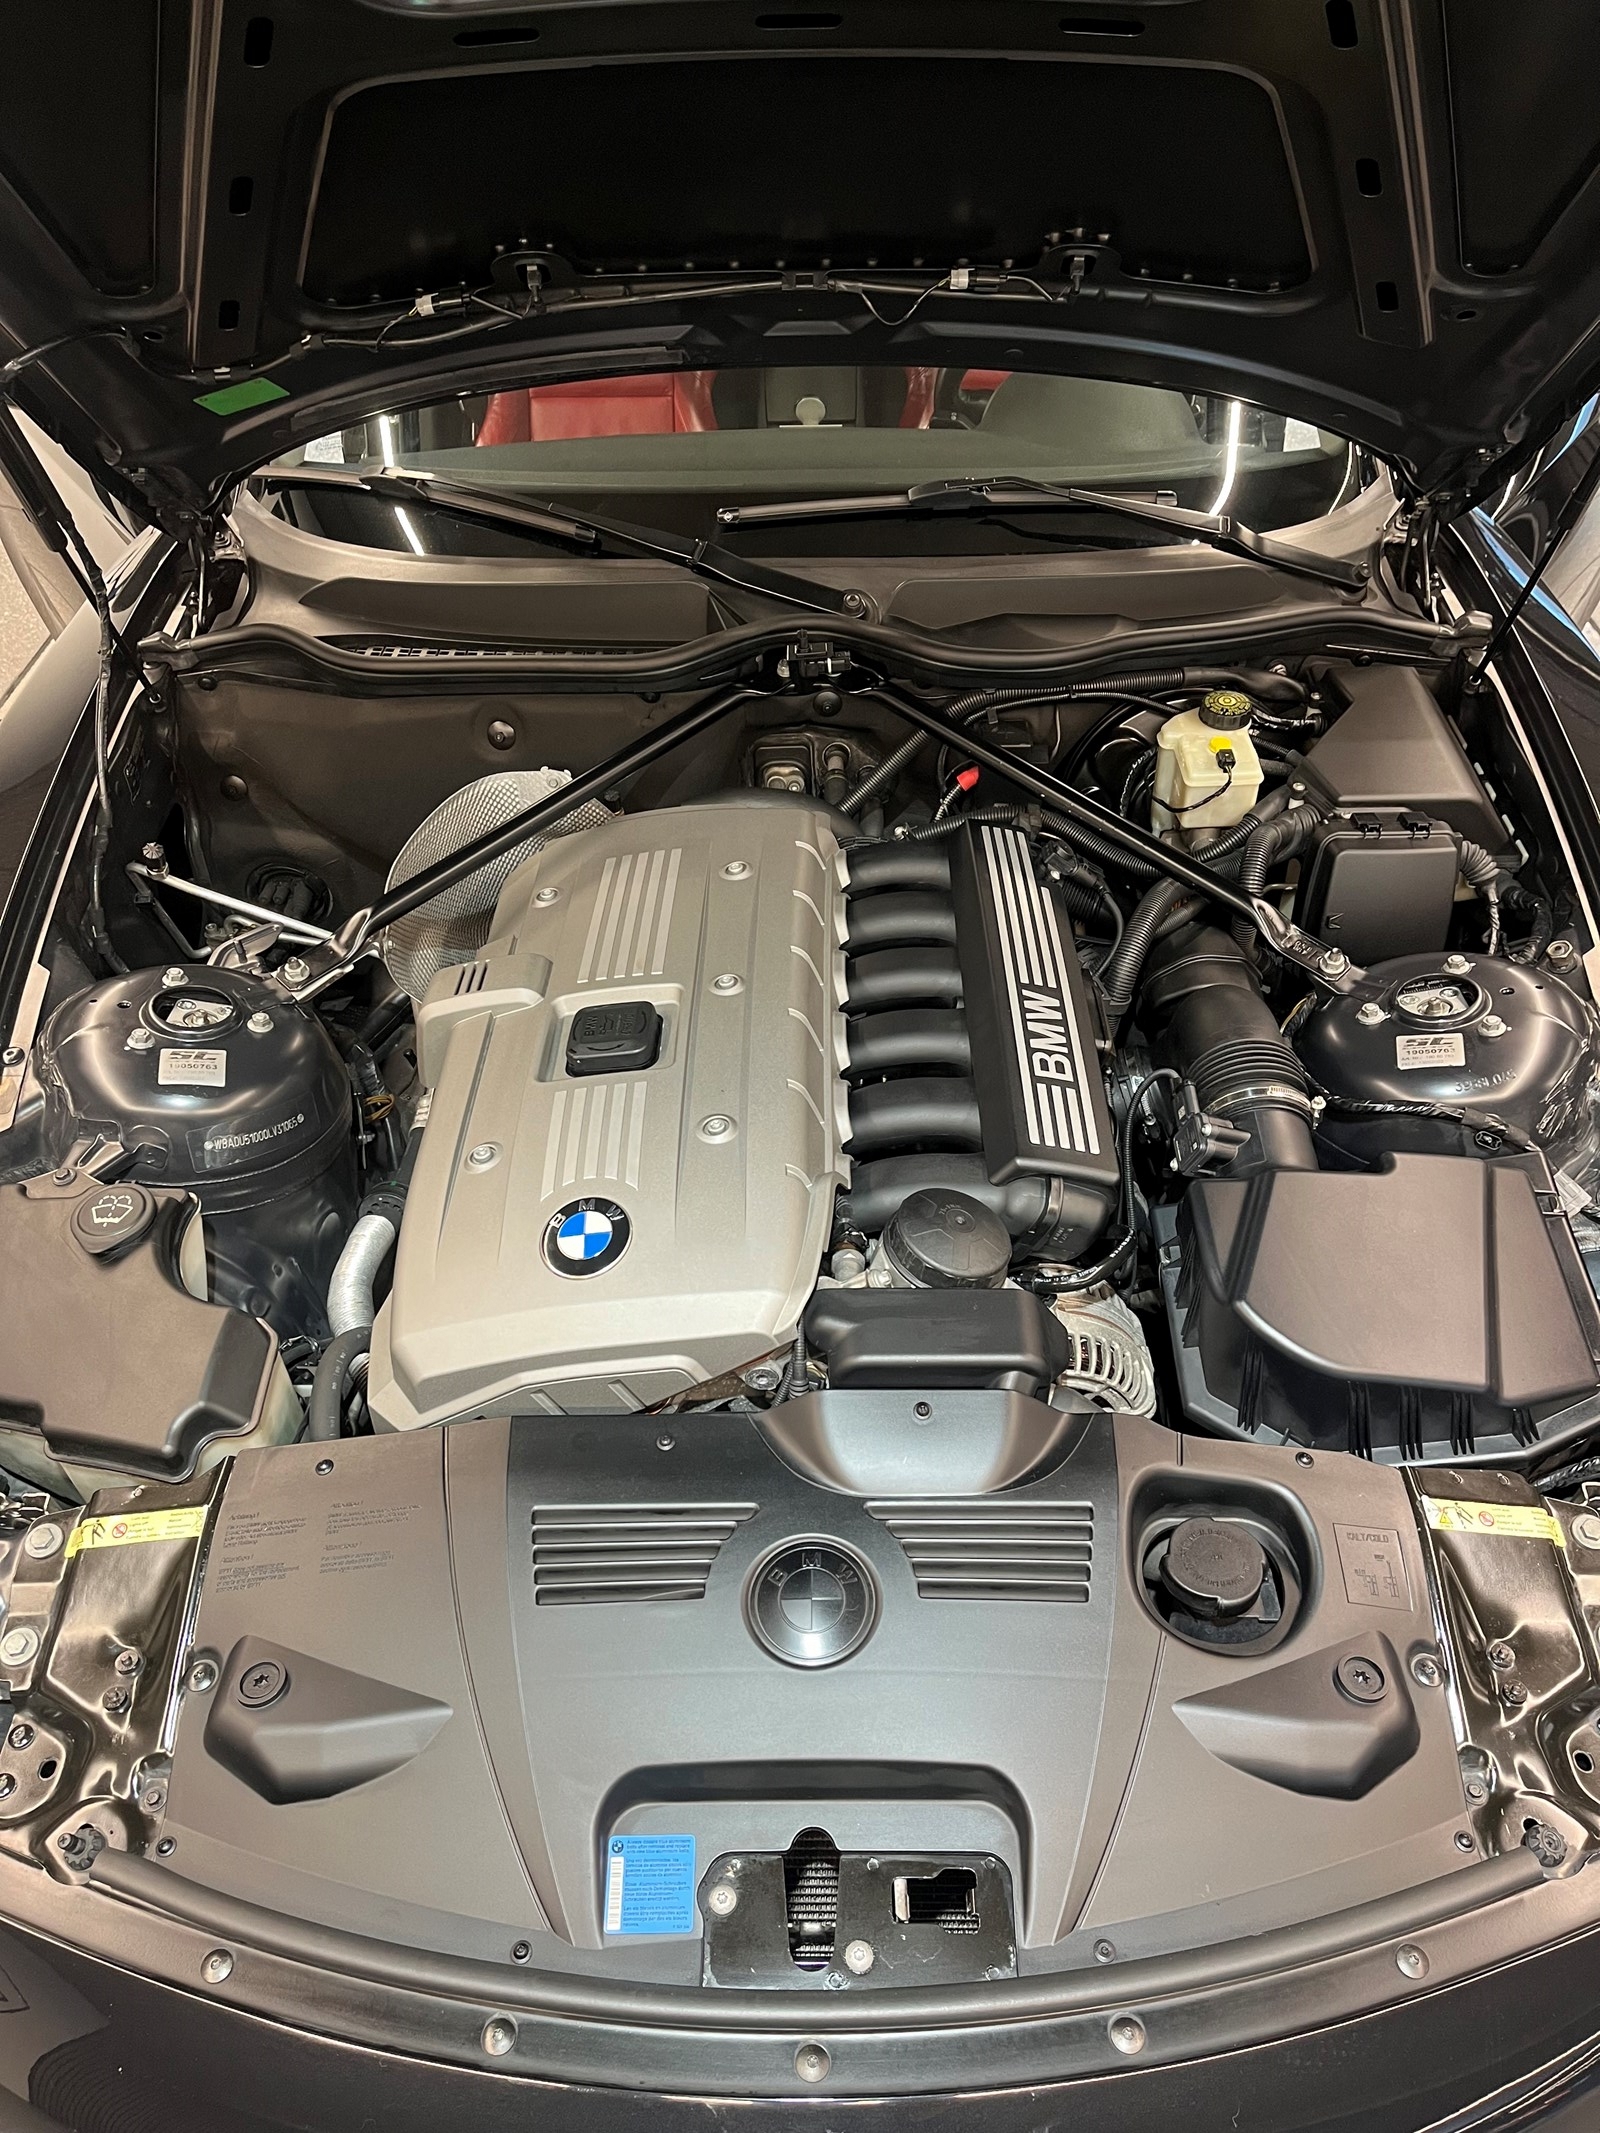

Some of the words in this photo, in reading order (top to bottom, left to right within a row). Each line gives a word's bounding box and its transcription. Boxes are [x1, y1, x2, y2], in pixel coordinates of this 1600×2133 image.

[1021, 988, 1074, 1082] BMW
[549, 1198, 625, 1229] BMW
[767, 1551, 858, 1587] BMW
